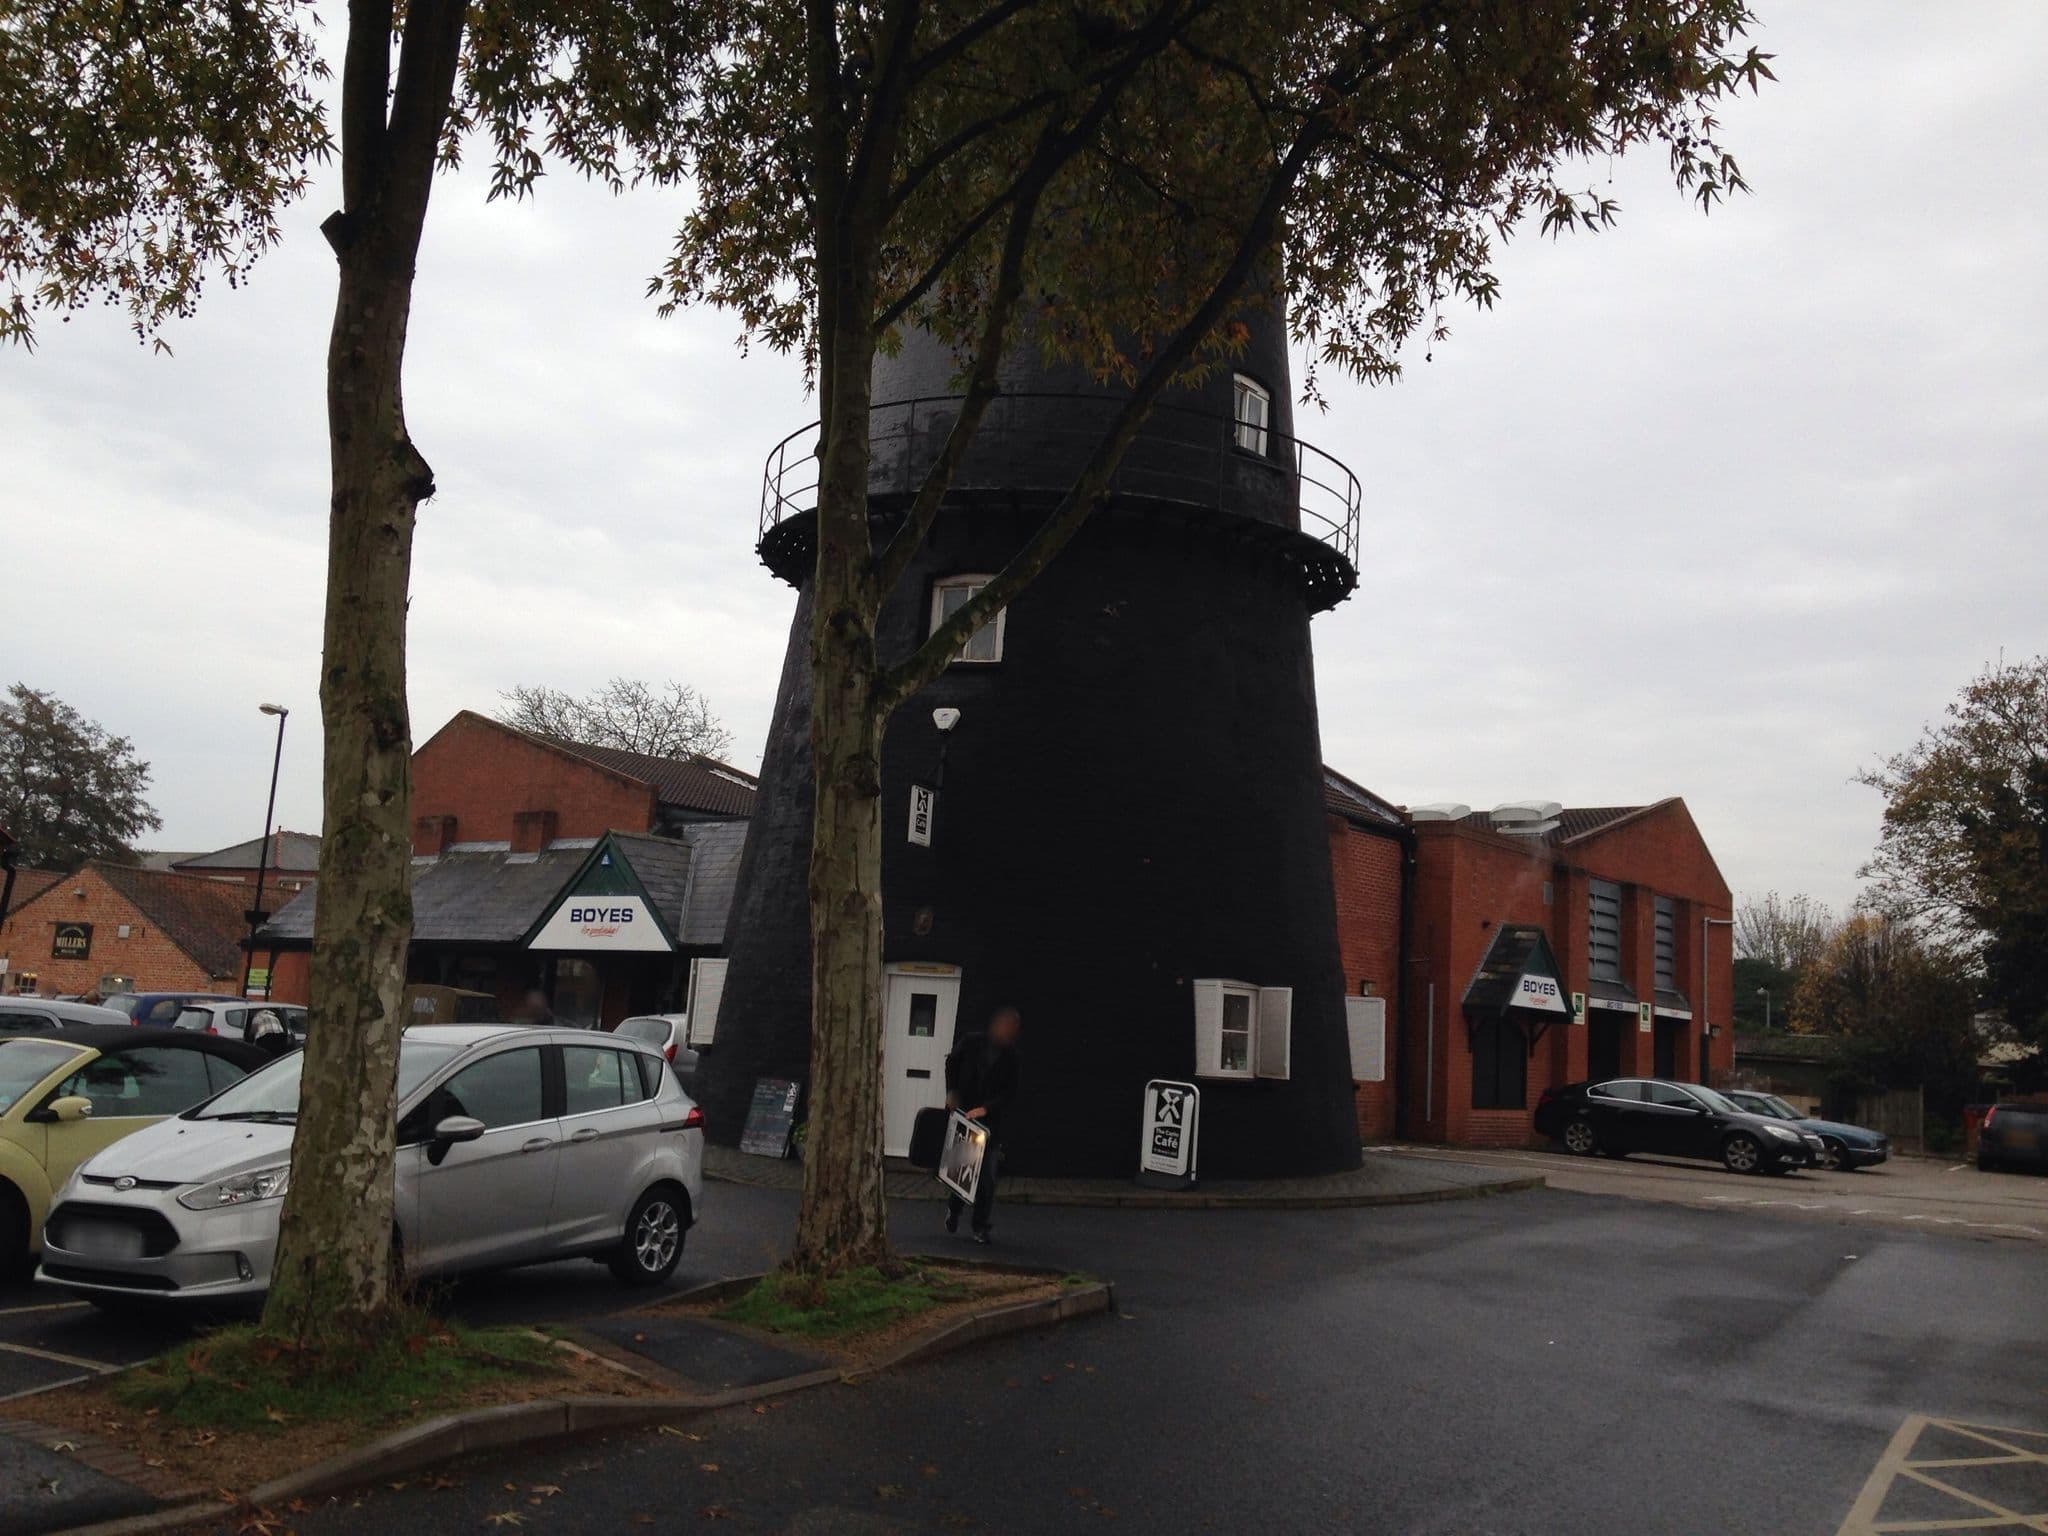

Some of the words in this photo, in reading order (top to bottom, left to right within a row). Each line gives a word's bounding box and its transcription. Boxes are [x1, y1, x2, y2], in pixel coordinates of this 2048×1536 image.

[571, 908, 634, 923] BOYES
[1523, 980, 1556, 996] BOYES
[1154, 1134, 1178, 1149] Café
